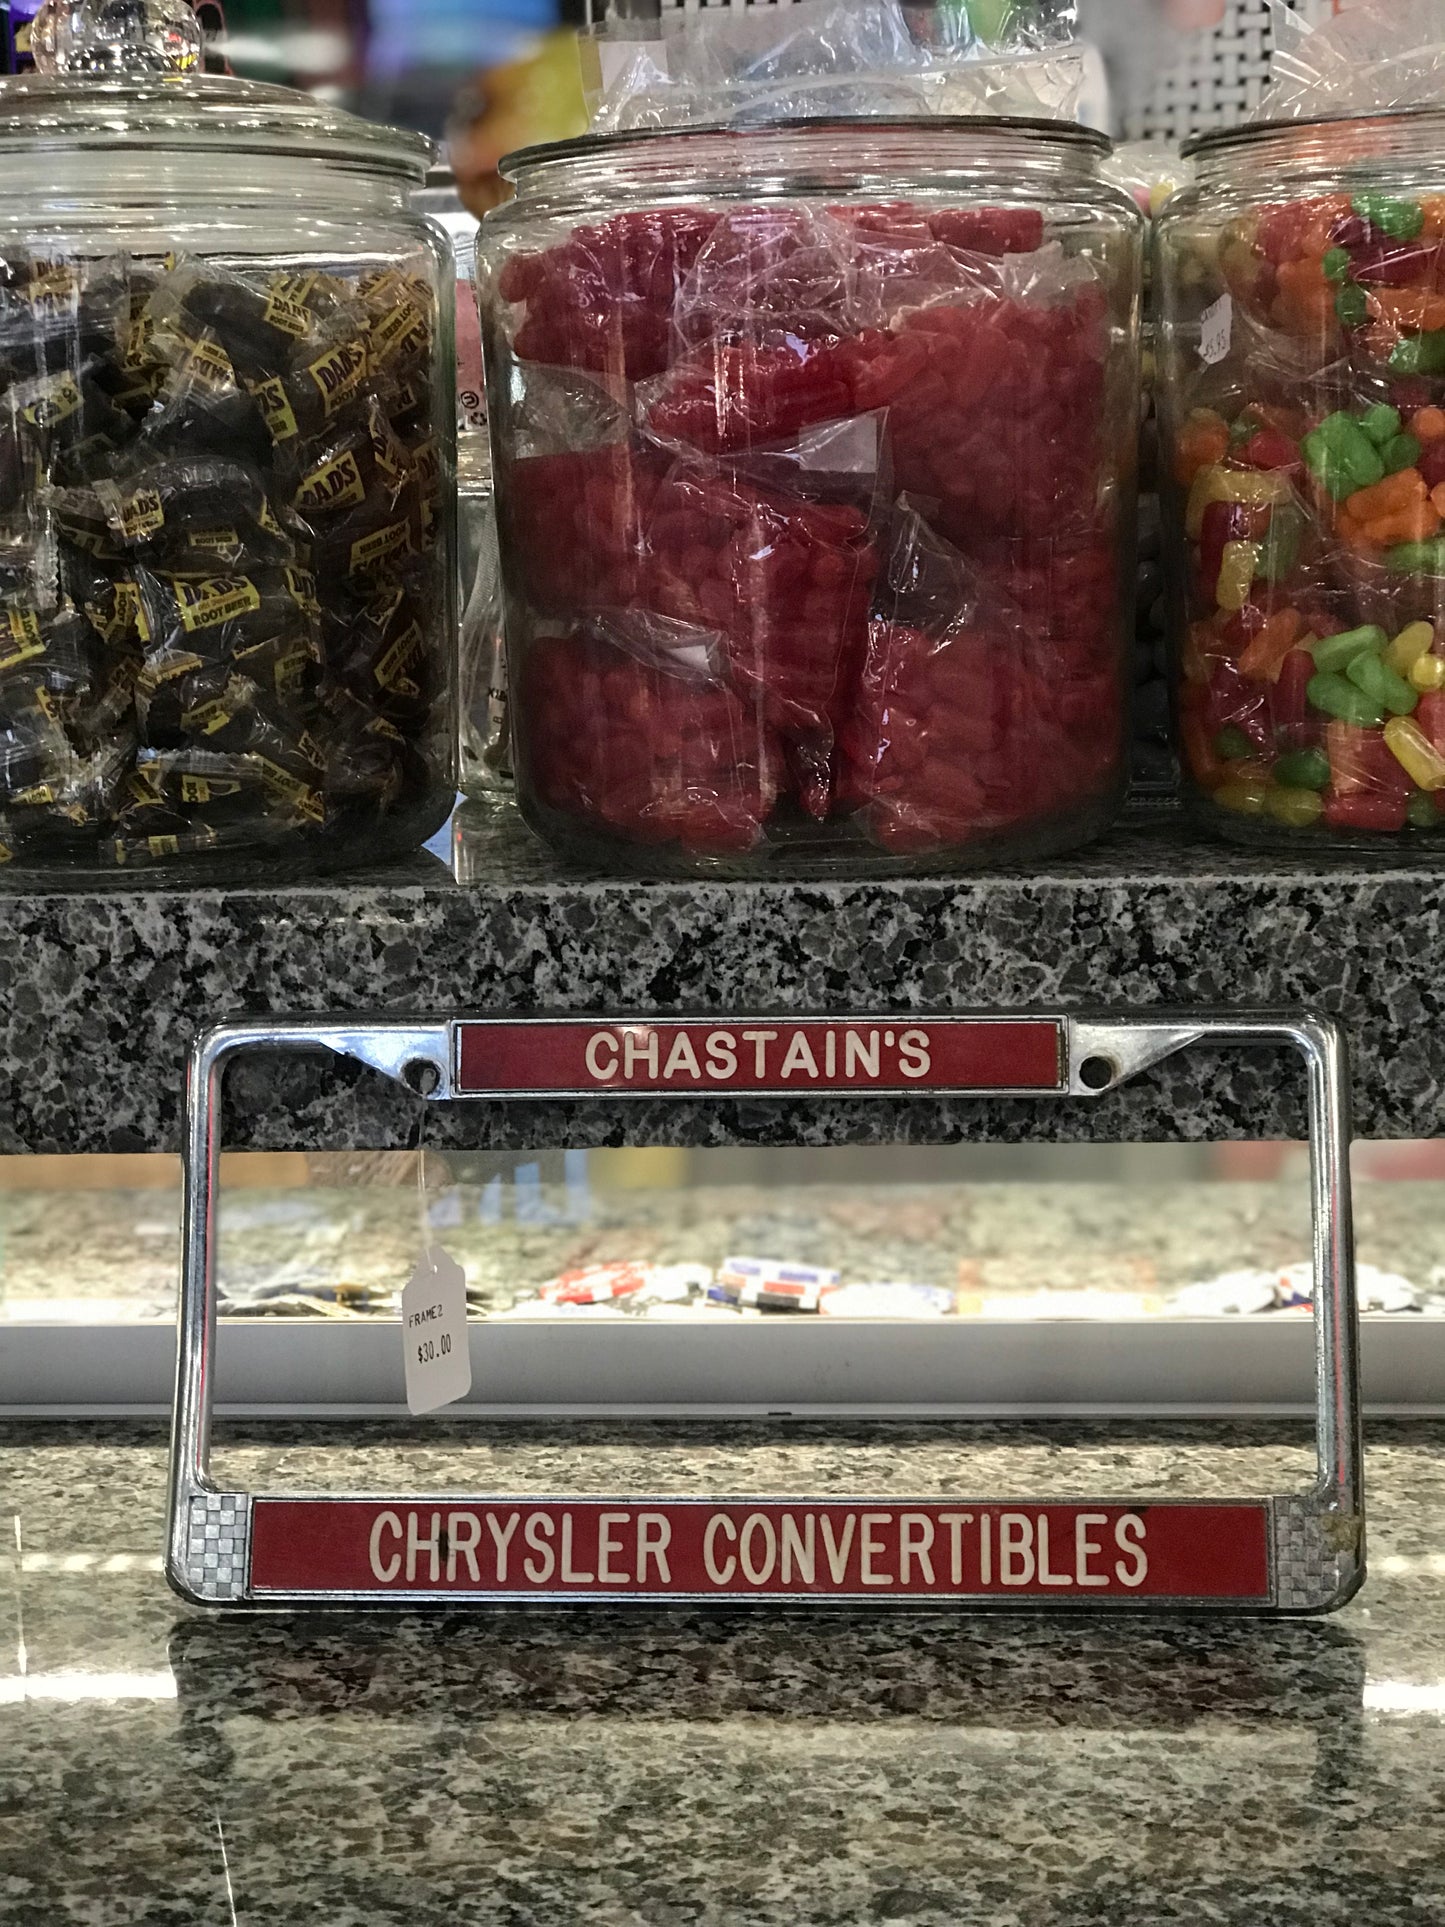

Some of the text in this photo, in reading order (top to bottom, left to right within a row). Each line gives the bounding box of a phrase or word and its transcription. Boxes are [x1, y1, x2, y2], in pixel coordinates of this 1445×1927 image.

[317, 345, 365, 393] DAD'S
[302, 457, 357, 506] DAD'S
[192, 605, 224, 626] ROOT
[223, 595, 252, 614] BEER
[585, 1029, 931, 1080] CHASTAIN'S
[409, 1303, 444, 1328] FRAME2
[417, 1333, 451, 1364] $30.00
[369, 1511, 1149, 1588] CHRYSLER CONVERTIBLES
